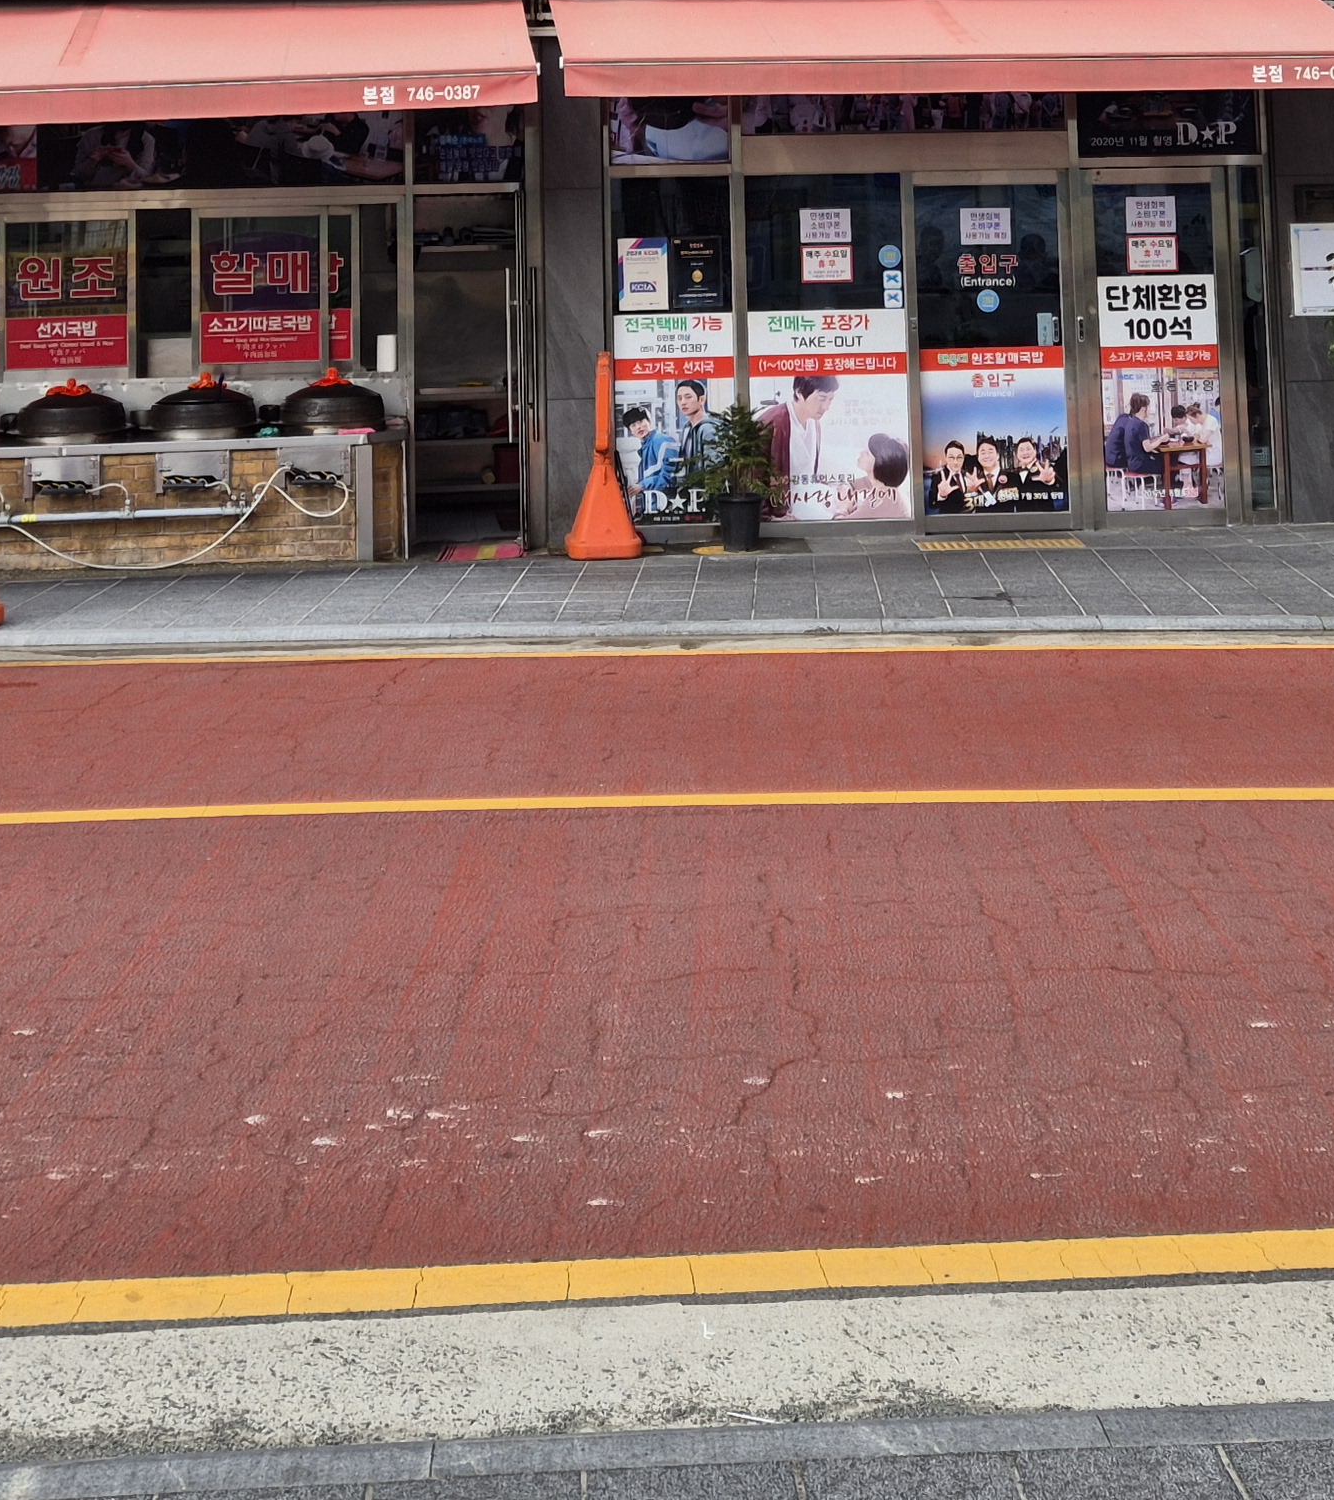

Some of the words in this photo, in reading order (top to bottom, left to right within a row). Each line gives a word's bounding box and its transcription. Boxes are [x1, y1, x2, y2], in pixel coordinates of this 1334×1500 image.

[1252, 65, 1283, 83] 본점
[362, 85, 395, 105] 본점
[407, 85, 480, 101] 746-0387
[957, 254, 1018, 274] 출입구
[17, 257, 116, 300] 원조
[210, 251, 309, 295] 할매
[960, 276, 1016, 287] (Entrance)
[1105, 283, 1207, 312] 단체환영
[36, 321, 97, 338] 선지국밥
[208, 315, 312, 333] 소고기따로국밥
[625, 316, 688, 333] 전국택배
[692, 315, 723, 332] 가능
[767, 315, 816, 332] 전메뉴
[821, 314, 870, 331] 포장가
[1124, 316, 1193, 341] 100석
[655, 343, 708, 354] 746-0387
[791, 335, 863, 348] TAKE-OUT
[823, 357, 897, 371] 포장해드립니다
[1176, 350, 1211, 362] 포장가능
[682, 360, 715, 374] 선지국
[971, 373, 1016, 388] 출입구
